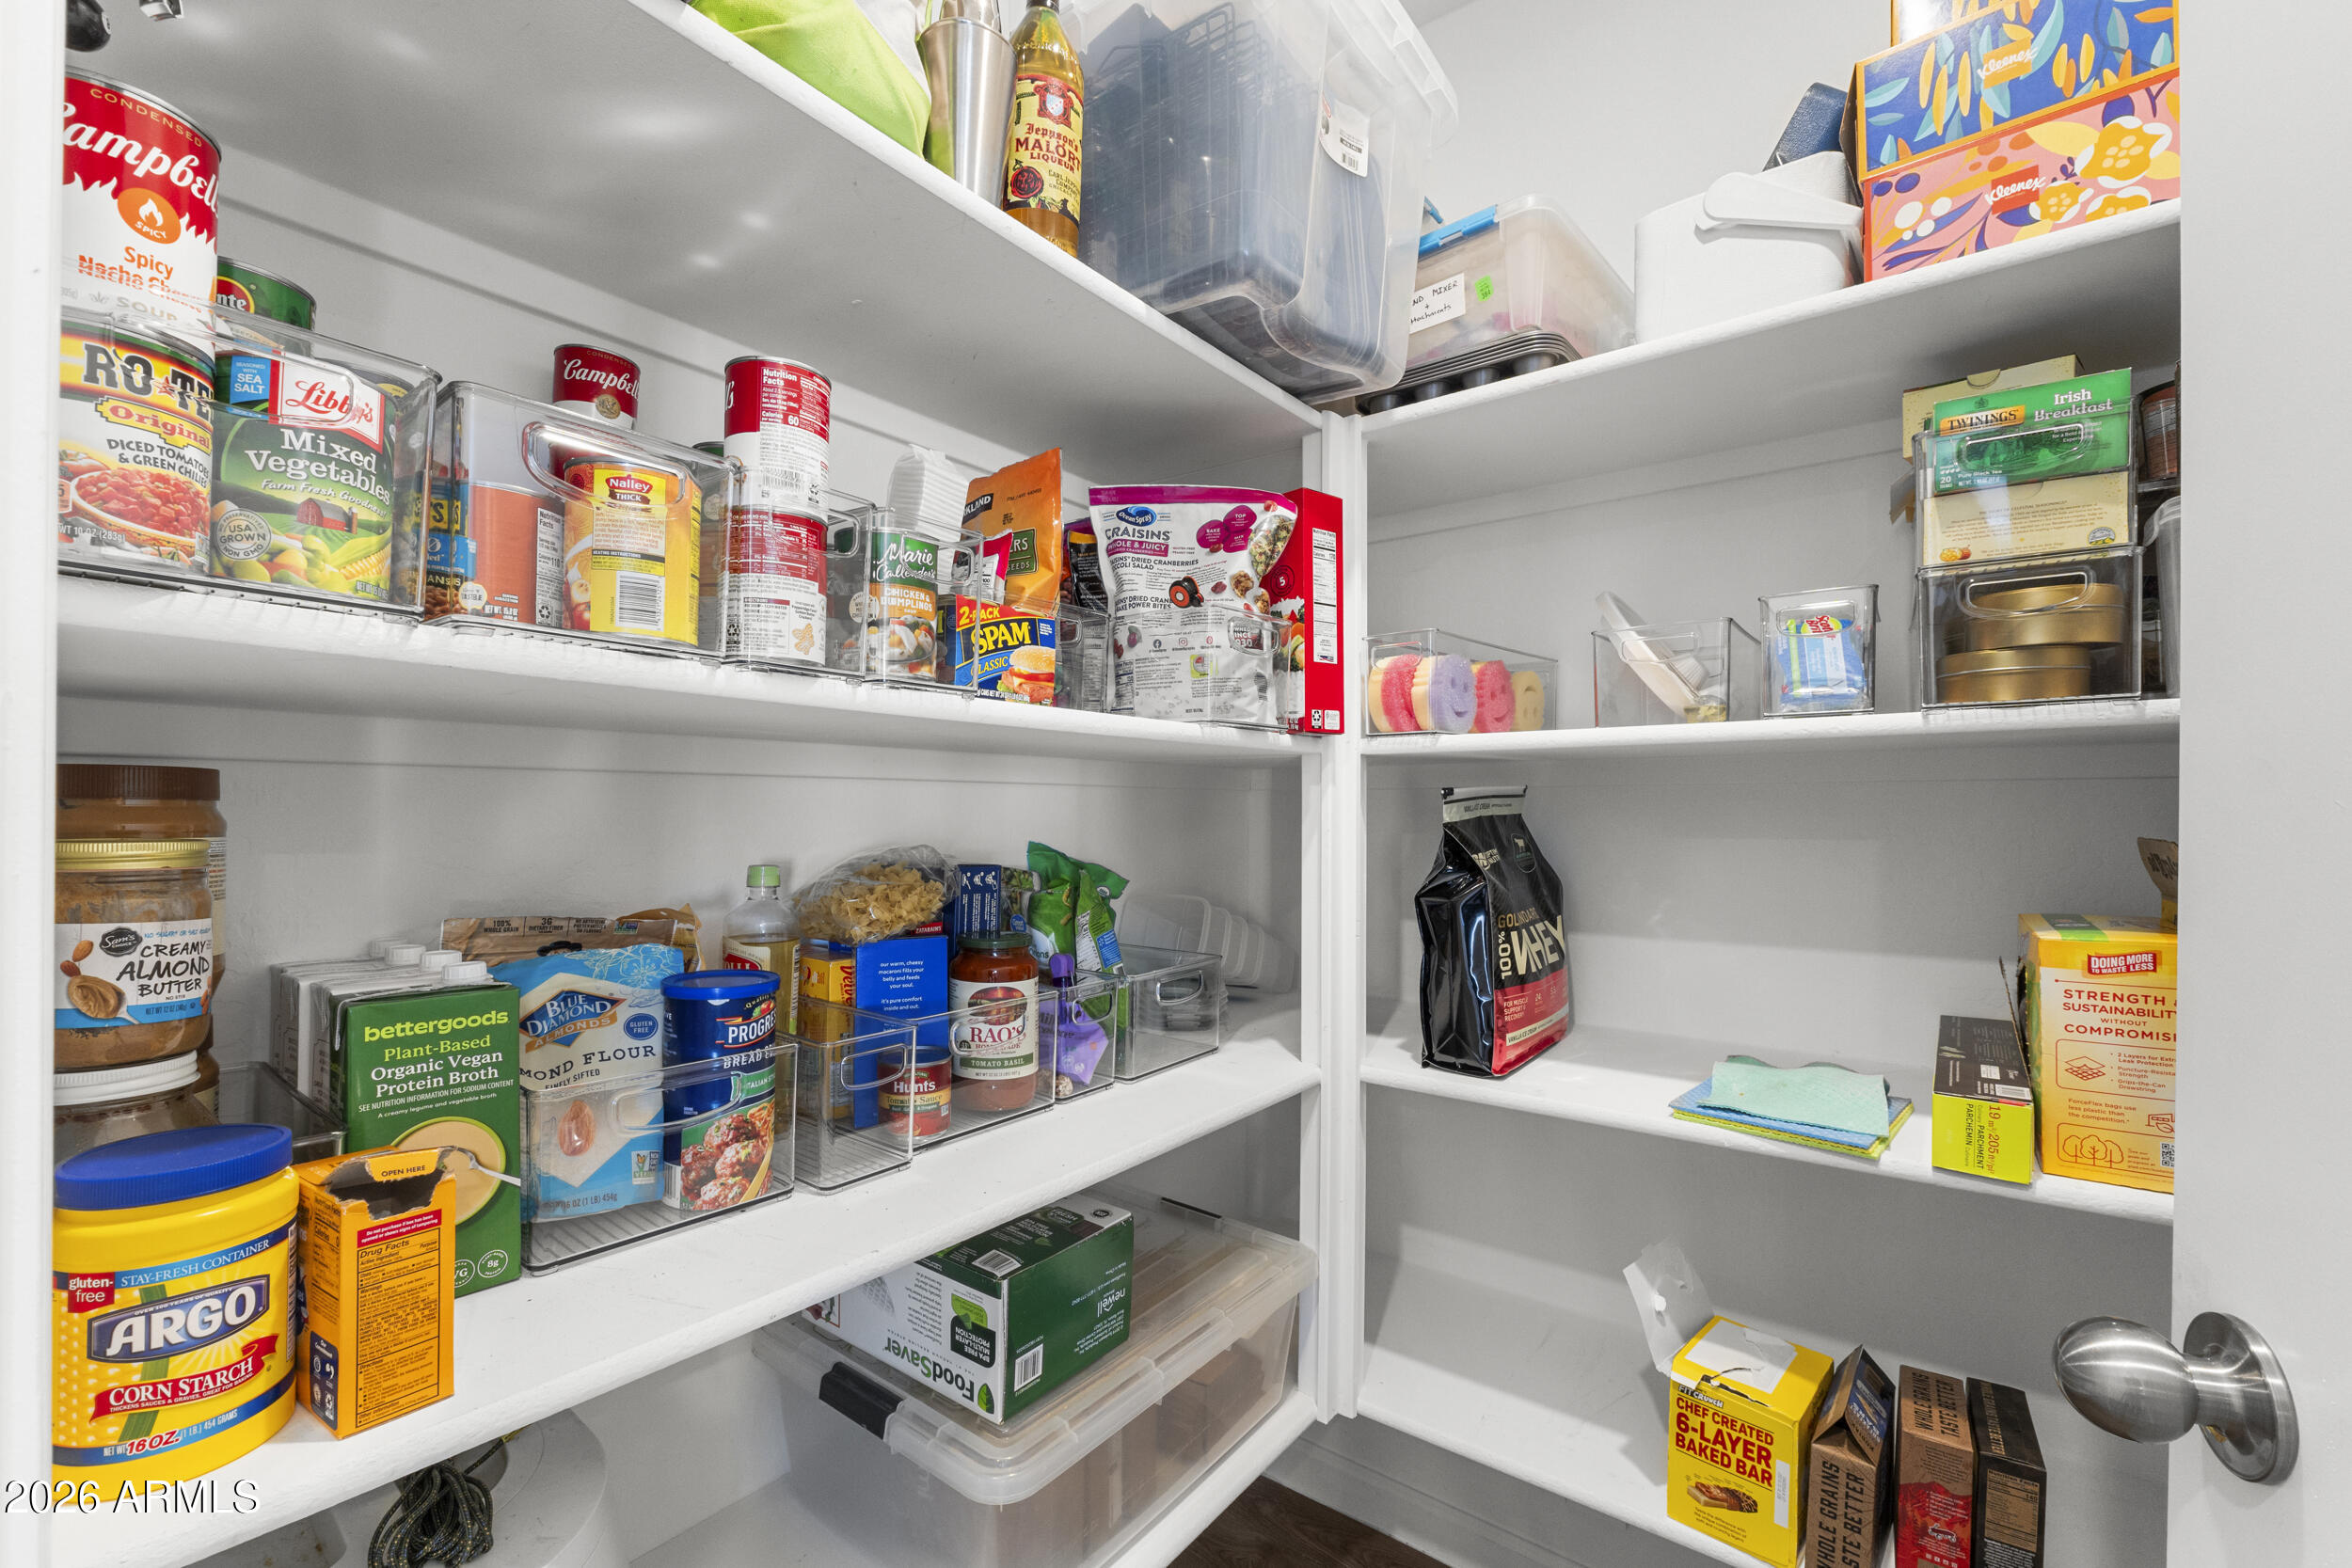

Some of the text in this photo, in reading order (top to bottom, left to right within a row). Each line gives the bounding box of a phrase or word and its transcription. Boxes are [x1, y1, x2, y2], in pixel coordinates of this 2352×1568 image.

[1977, 47, 2038, 80] Kleenex
[90, 88, 201, 147] CONDENSED
[1025, 123, 1078, 151] Jeppson's
[1030, 152, 1074, 173] LIQUEUR
[1984, 177, 2046, 205] Kleenex
[135, 221, 167, 239] SPICY
[124, 246, 173, 280] Spicy
[1412, 280, 1458, 306] ND MIXER
[1410, 304, 1451, 324] ttachments
[237, 373, 262, 384] SEA
[763, 369, 797, 381] Nutrition
[763, 376, 784, 386] Facts
[234, 383, 264, 394] SALT
[2055, 388, 2091, 405] Irish
[285, 379, 373, 424] Libby's
[2034, 399, 2113, 421] Breakfast
[109, 404, 210, 449] Original
[788, 416, 799, 425] 60
[1947, 409, 2017, 431] TWININGS
[106, 438, 209, 478] DICED TOMATOES
[280, 429, 377, 474] Mixed
[119, 452, 207, 489] & GREEN CHILIES
[245, 450, 390, 507] Vegetables
[1940, 476, 1951, 484] 20
[262, 479, 297, 491] Farm
[299, 482, 336, 498] Fresh
[610, 479, 649, 492] Nalley
[616, 493, 642, 501] THICK
[963, 496, 992, 515] KLAND
[230, 524, 251, 533] USA
[1119, 513, 1151, 524] Ocean Spray
[219, 533, 266, 543] GROWN
[1105, 527, 1170, 541] CRAISINS
[1108, 540, 1131, 550] WHOLE
[1142, 542, 1166, 550] JUICY
[223, 543, 263, 557] NON GMO
[877, 543, 933, 565] Marie
[885, 588, 925, 599] CHICKEN
[1279, 577, 1286, 587] 5
[881, 596, 932, 611] DUMPLINGS
[959, 605, 1000, 626] 2-PACK
[971, 621, 1031, 654] SPAM
[972, 657, 1009, 675] CLASSIC
[103, 934, 135, 948] Sam's
[140, 941, 206, 958] CREAMY
[1511, 915, 1565, 975] WHEY
[1499, 932, 1512, 979] 100%
[2091, 954, 2153, 968] DOING MORE
[116, 957, 209, 981] ALMOND
[137, 978, 201, 997] BUTTER
[2063, 990, 2166, 1006] STRENGTH
[546, 994, 588, 1017] BLUE
[365, 1010, 509, 1042] bettergoods
[528, 1001, 612, 1037] DIAMOND
[534, 1017, 610, 1048] ALMONDS
[970, 1025, 1025, 1043] RAO'S
[384, 1035, 490, 1061] Plant-Based
[371, 1052, 502, 1081] Organic Vegan
[519, 1046, 656, 1080] MOND FLOUR
[376, 1067, 499, 1098] Protein Broth
[573, 1069, 600, 1082] SIFTED
[372, 1098, 405, 1110] NUTRITION
[406, 1090, 449, 1103] INFORMATION
[463, 1085, 486, 1093] SODIUM
[488, 1079, 514, 1089] CONTENT
[919, 1095, 943, 1103] Sauce
[385, 1108, 408, 1117] creamy
[410, 1104, 433, 1113] legume
[449, 1096, 479, 1105] vegetable
[1965, 1104, 1974, 1146] PARCHEMIN
[1988, 1106, 2001, 1154] 19 205
[381, 1168, 404, 1177] OPEN
[360, 1241, 409, 1259] Drug Facts
[121, 1240, 269, 1287] STAY-FRESH CONTAINER
[70, 1276, 113, 1291] gluten-
[76, 1290, 105, 1303] free
[1098, 1288, 1125, 1317] newell
[106, 1287, 256, 1356] ARGO
[109, 1356, 254, 1406] CORN STARCH
[883, 1338, 974, 1402] FoodSaver
[110, 1403, 139, 1412] THICKENS
[174, 1394, 200, 1402] GRAVIES.
[203, 1388, 221, 1397] GREAT
[234, 1372, 253, 1386] BAKING.
[1936, 1380, 1957, 1410] BETTER
[1677, 1397, 1773, 1446] CHEF CREATED
[1914, 1402, 1934, 1431] WHOLE
[1940, 1412, 1961, 1438] TASTE
[103, 1409, 238, 1456] NET 16 OZ. 454 GRAMS
[1677, 1412, 1772, 1469] 6-LAYER
[1676, 1433, 1772, 1488] BAKED BAR
[1817, 1461, 1840, 1568] WHOLE GRAINS
[1842, 1472, 1864, 1568] STE BETTER
